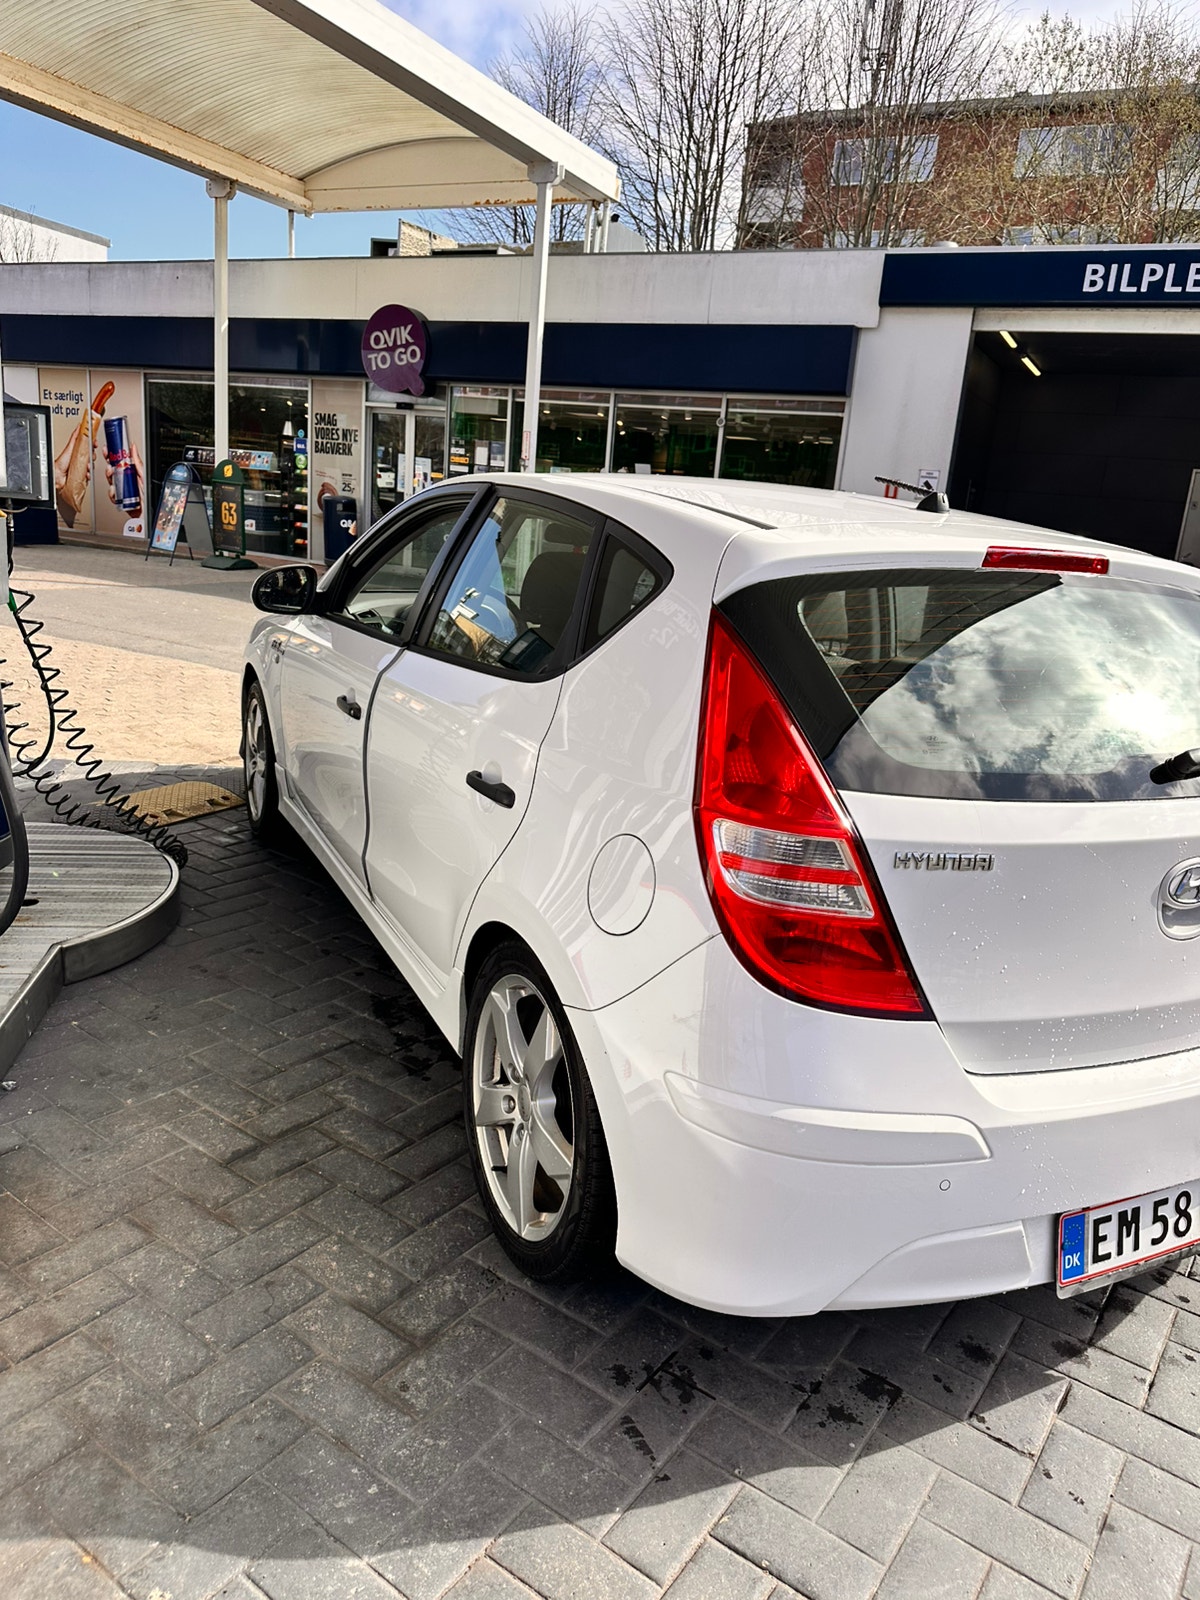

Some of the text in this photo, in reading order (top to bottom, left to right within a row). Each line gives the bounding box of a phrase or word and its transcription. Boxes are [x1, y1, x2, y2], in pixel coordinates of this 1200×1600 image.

[369, 324, 414, 349] QVIK
[367, 345, 421, 371] TO GO
[43, 389, 84, 404] Et særligt
[65, 406, 80, 418] par
[315, 412, 337, 426] SMAG
[315, 427, 359, 443] VORES NYE
[315, 441, 353, 456] BAGVÆRK
[222, 502, 237, 525] 63
[893, 851, 996, 872] HYUNDAI
[1092, 1206, 1141, 1264] EM
[1064, 1252, 1081, 1269] DK
